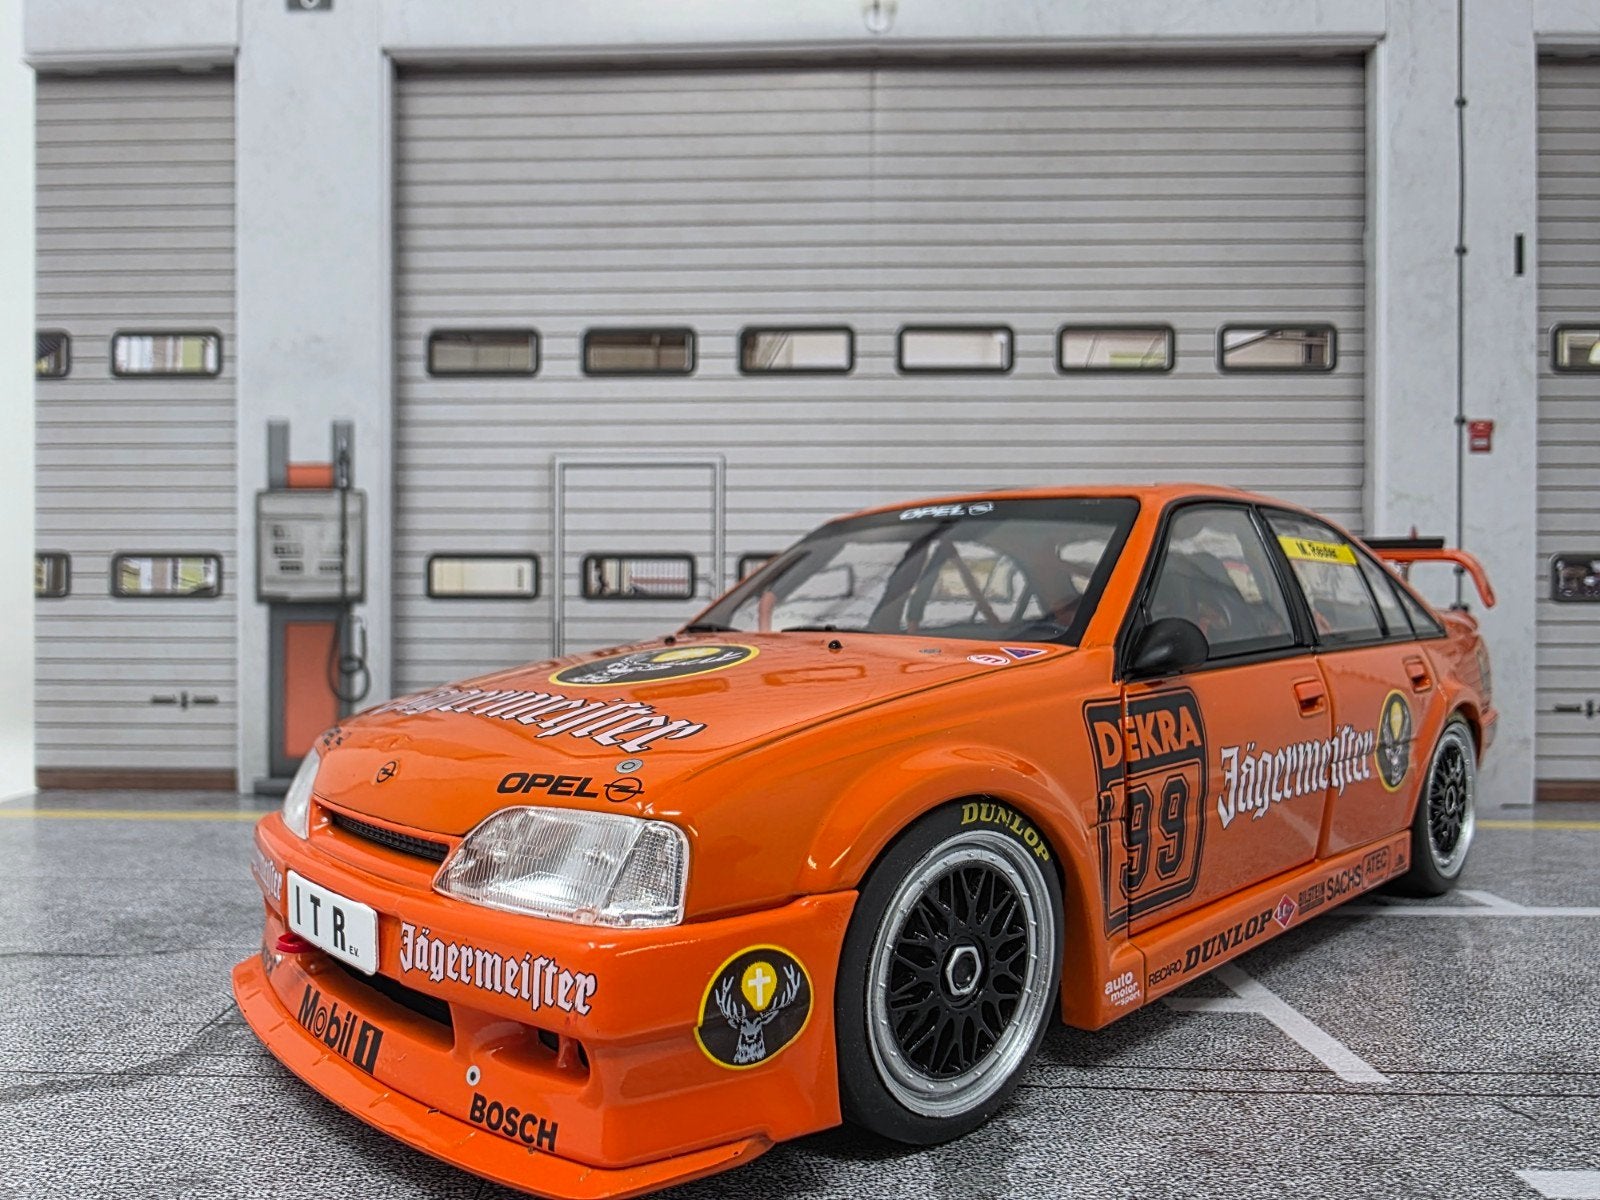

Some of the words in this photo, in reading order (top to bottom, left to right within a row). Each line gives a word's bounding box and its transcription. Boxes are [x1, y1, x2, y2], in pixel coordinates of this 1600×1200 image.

[900, 504, 964, 520] OPEL
[1094, 705, 1202, 770] DEKRA
[497, 772, 598, 799] OPEL
[961, 802, 1050, 862] DUNLOP
[1326, 863, 1362, 901] SACHS
[1183, 908, 1273, 974] DUNLOP
[400, 921, 598, 1017] Jägermeister
[1104, 971, 1134, 995] auto
[1111, 981, 1139, 1002] motor
[1148, 959, 1182, 987] RECARO
[298, 983, 358, 1057] Mobil
[357, 1021, 381, 1072] 1
[469, 1092, 559, 1152] BOSCH
